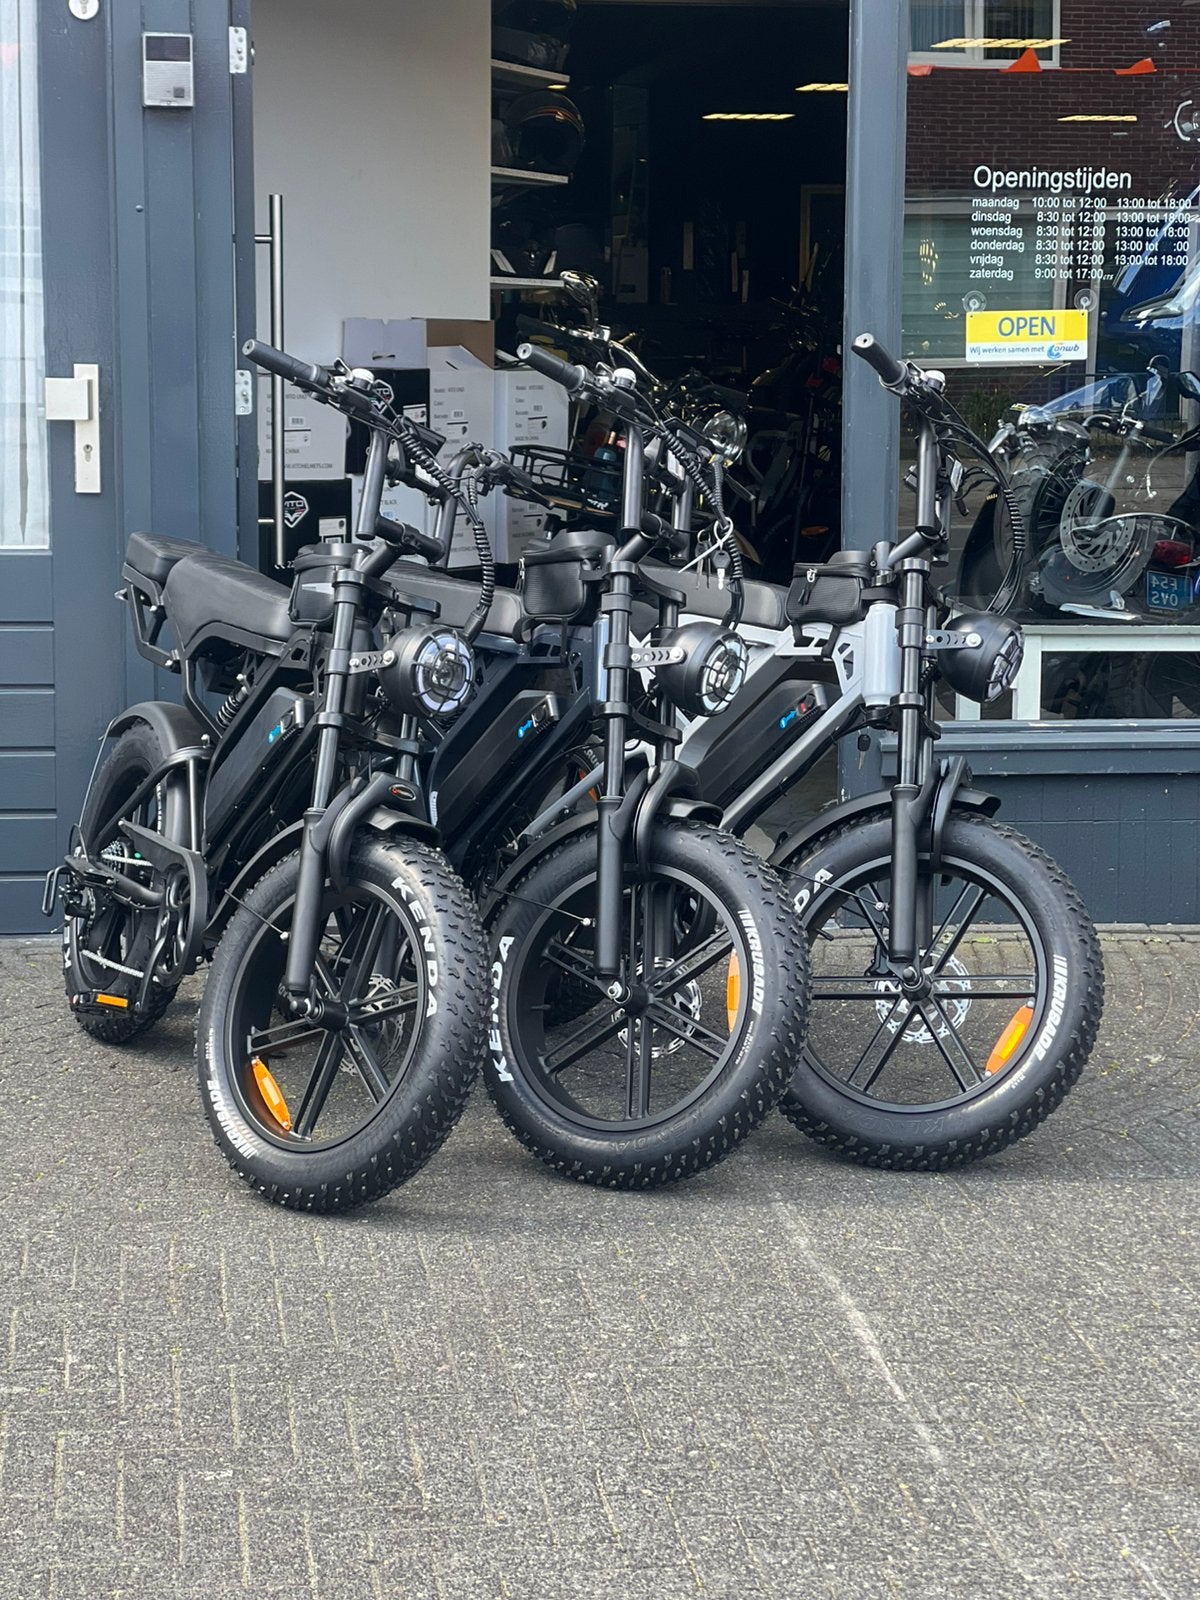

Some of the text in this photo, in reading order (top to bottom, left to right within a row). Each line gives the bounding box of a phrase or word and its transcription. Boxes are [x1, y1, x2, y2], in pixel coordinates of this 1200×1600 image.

[973, 166, 1132, 193] Openingstijden
[972, 198, 1192, 211] maandag 10:00 tot 12:00 13:00 tot 18:00
[971, 211, 1191, 224] dinsdag 8:30 tot 12:00 13:00 tot 18:00
[971, 226, 1191, 239] woensdag 8:30 tot 12:00 13:00 tot 18:00
[970, 240, 1025, 252] donderdag
[1036, 240, 1058, 251] 8:30
[1060, 240, 1074, 251] tot
[1077, 240, 1105, 251] 12:00
[1115, 240, 1143, 251] 13:00
[1145, 240, 1159, 251] tot
[970, 254, 1189, 266] vrijdag 8:30 tot 12:00 13:00 tot 18:00
[969, 268, 1103, 280] zaterdag 9:00 tot 17:00
[998, 316, 1056, 337] OPEN
[969, 346, 981, 356] Wij
[391, 876, 438, 1018] KENDA
[742, 925, 765, 1016] KRUSADE
[488, 936, 516, 1082] KENDA
[1034, 968, 1068, 1062] KRUSADE
[206, 1079, 249, 1152] KRUSADE
